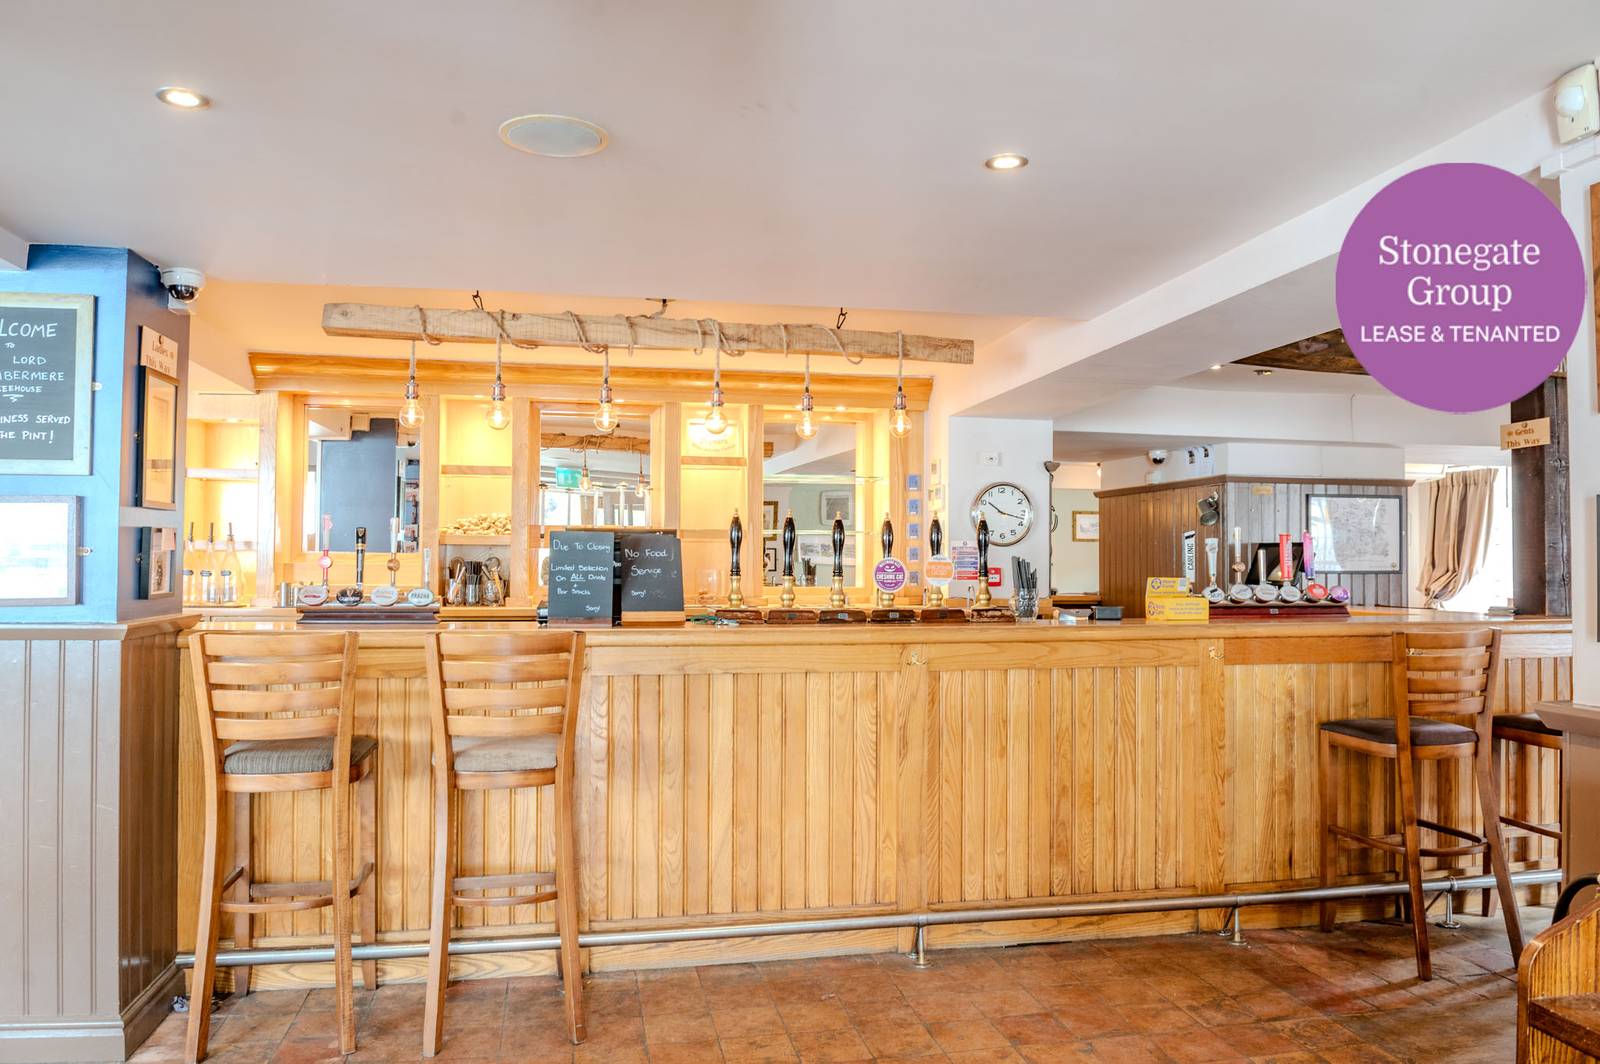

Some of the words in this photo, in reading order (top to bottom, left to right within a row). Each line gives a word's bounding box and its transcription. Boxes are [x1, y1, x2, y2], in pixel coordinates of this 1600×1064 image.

[13, 355, 47, 365] LORD
[0, 370, 65, 381] BERMERE
[35, 414, 71, 424] SERVED
[22, 430, 54, 444] PINT!
[574, 542, 584, 550] To
[624, 548, 640, 558] No
[645, 548, 667, 557] Food
